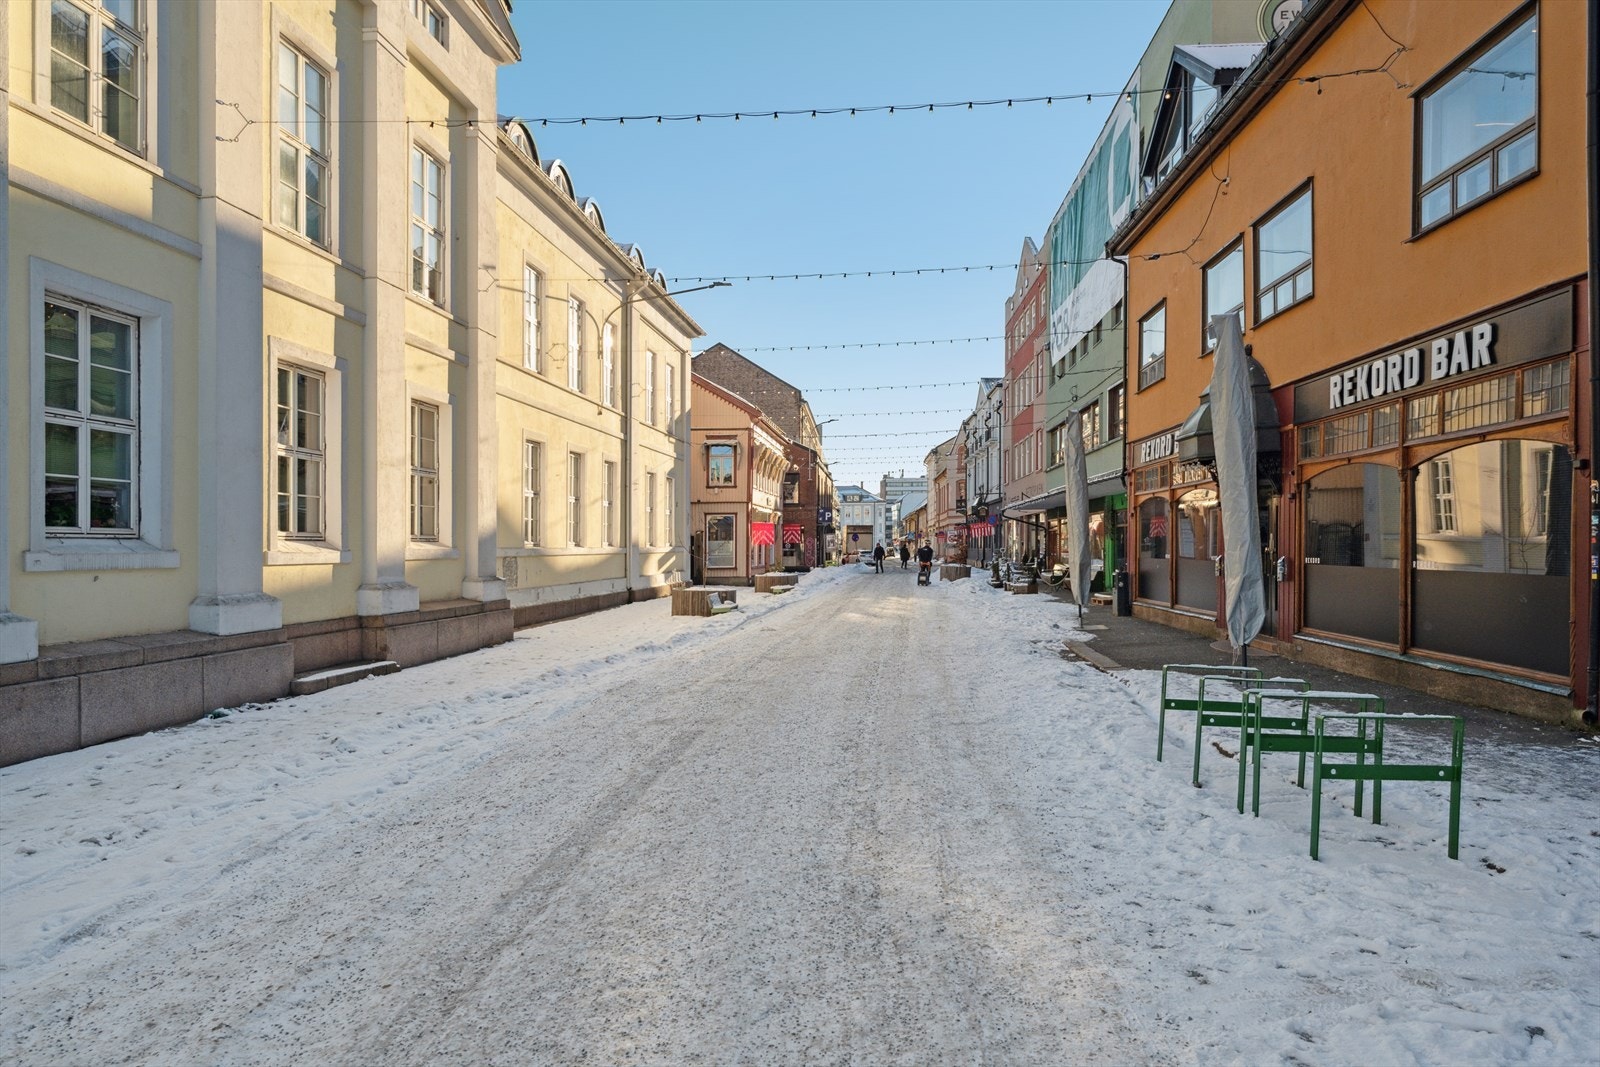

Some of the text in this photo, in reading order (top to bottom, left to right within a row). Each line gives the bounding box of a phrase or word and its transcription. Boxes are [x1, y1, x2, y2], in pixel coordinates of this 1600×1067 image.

[1330, 322, 1492, 409] REKORD BAR
[1141, 433, 1171, 463] REKORD
[825, 512, 832, 521] P
